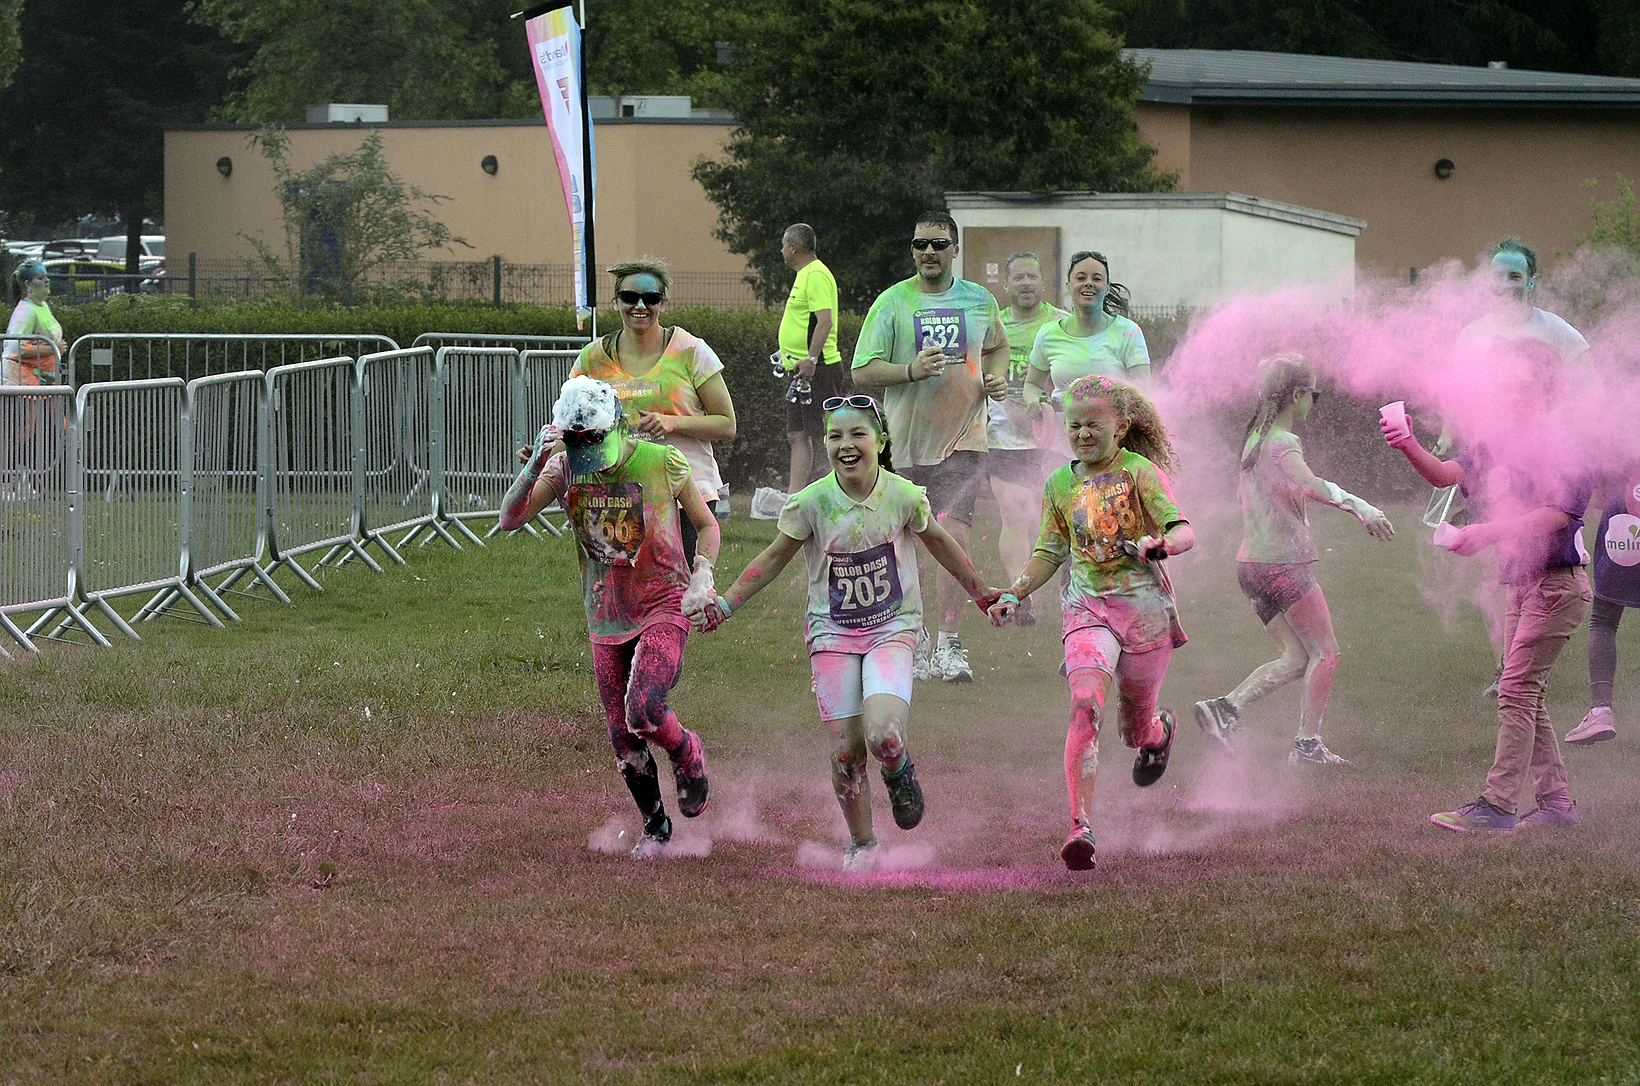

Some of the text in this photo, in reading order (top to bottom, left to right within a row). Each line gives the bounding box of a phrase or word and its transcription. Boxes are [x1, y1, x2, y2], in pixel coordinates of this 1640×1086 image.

[920, 316, 960, 325] KOLOR DASH
[607, 496, 632, 508] DASH
[832, 555, 888, 578] KOLOR DASH
[837, 567, 892, 610] 205
[867, 608, 891, 621] POWER
